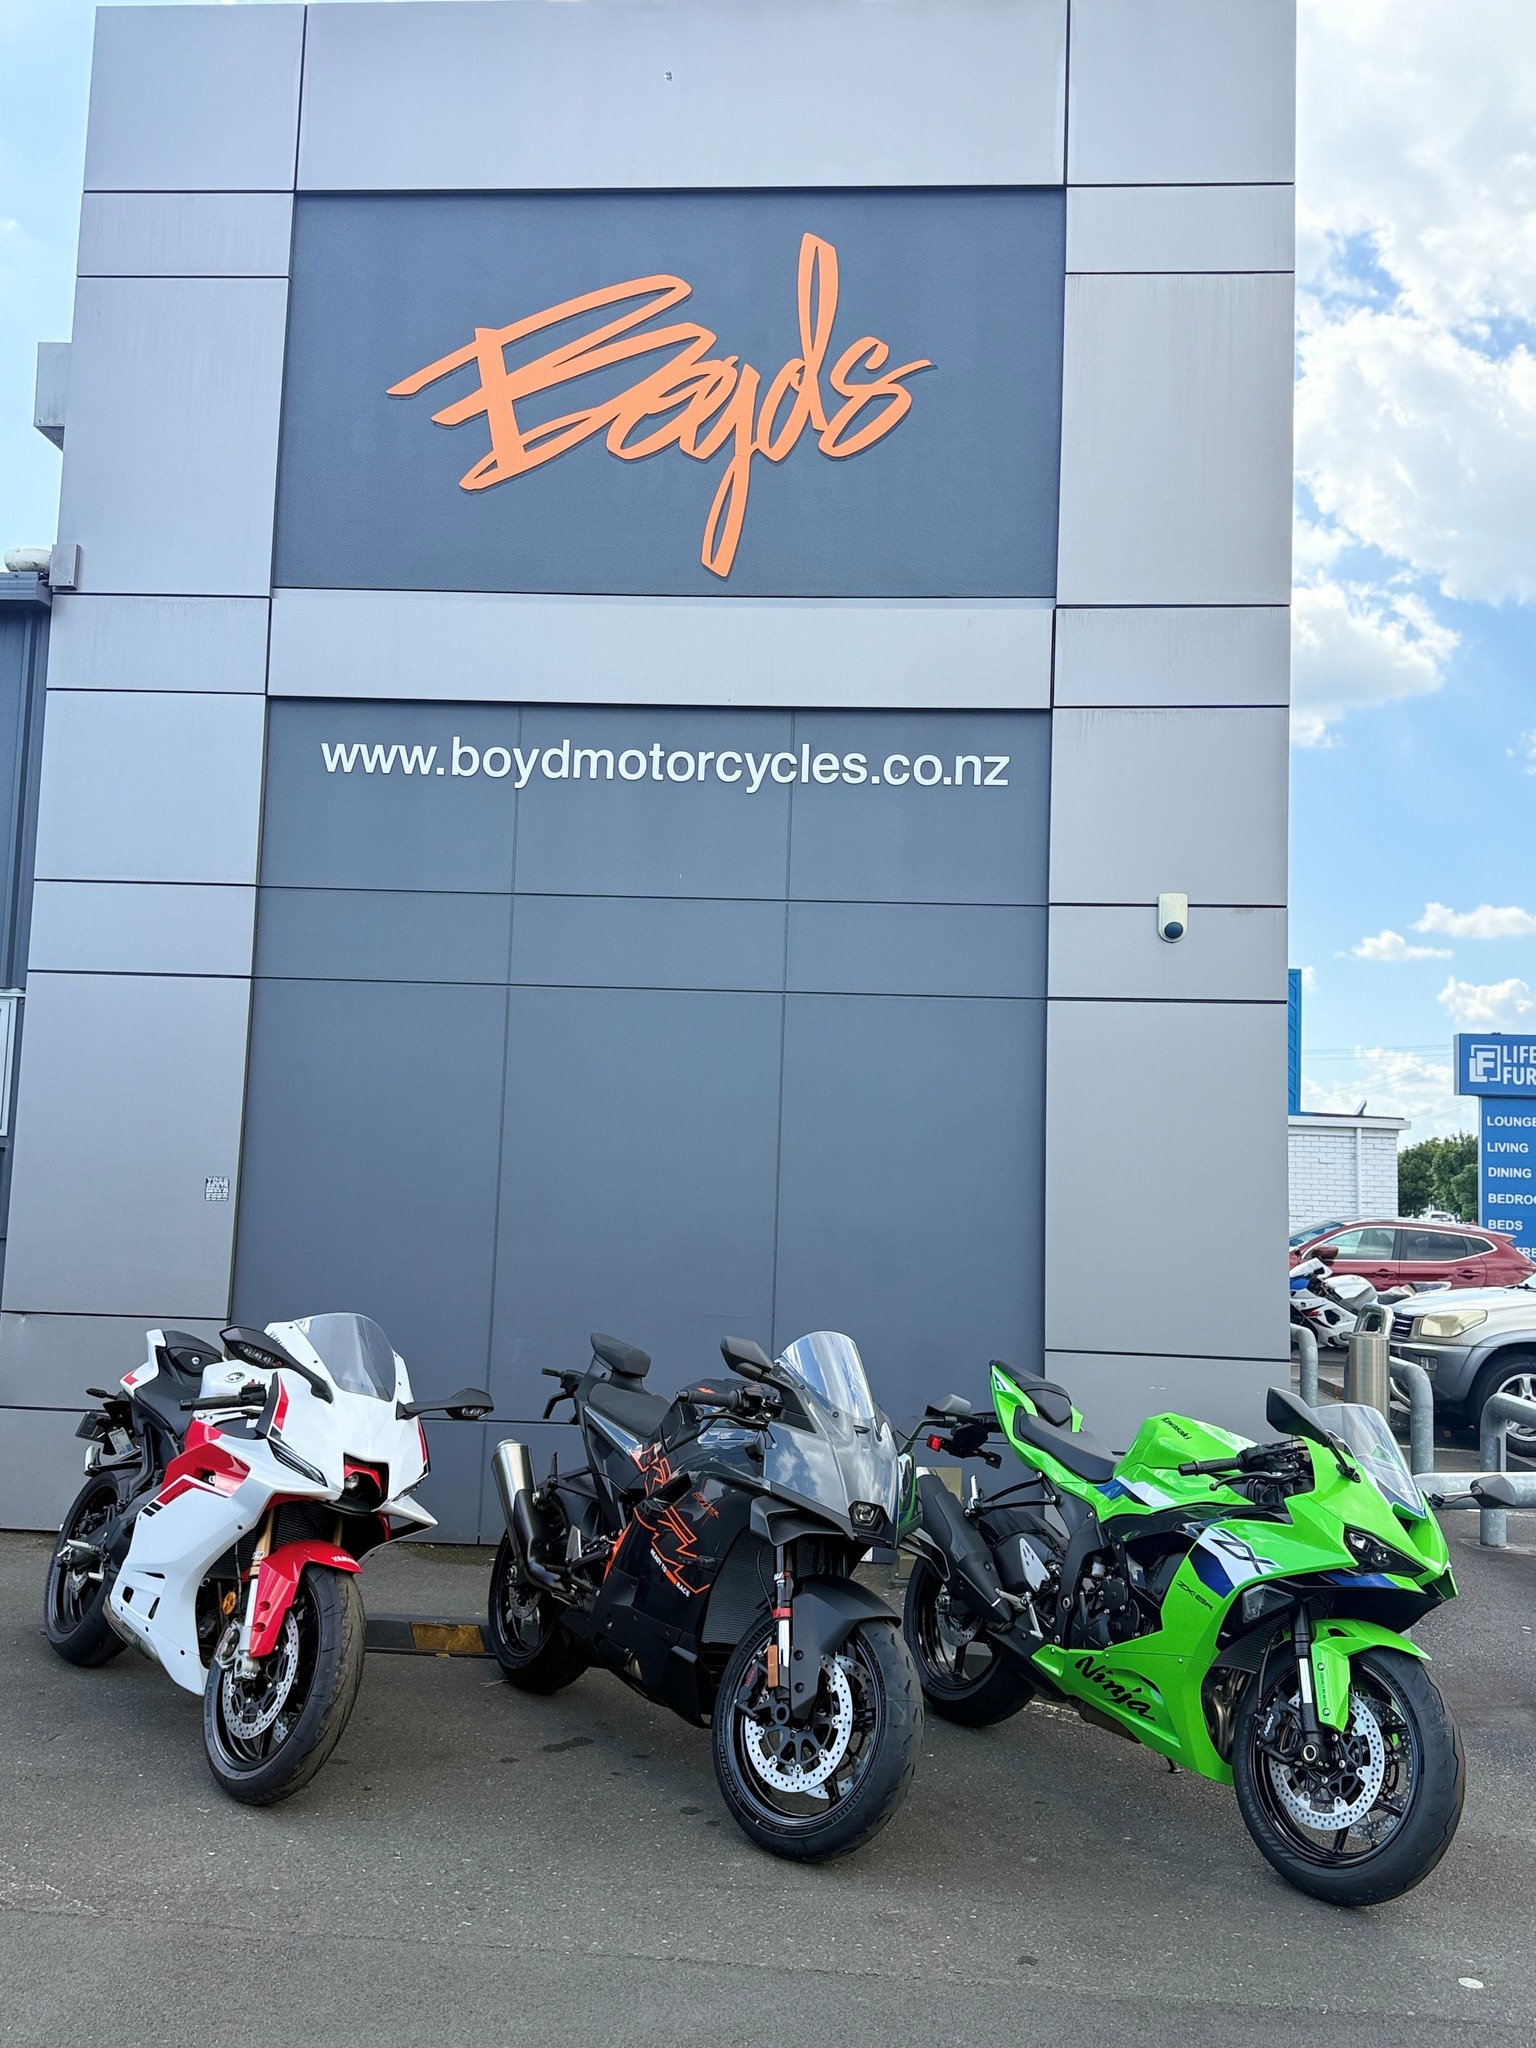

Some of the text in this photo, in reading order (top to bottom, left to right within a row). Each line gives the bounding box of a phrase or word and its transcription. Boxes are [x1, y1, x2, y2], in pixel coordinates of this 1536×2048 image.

[386, 232, 931, 578] Boyds
[321, 736, 1011, 794] www.boydmotorcycles.co.nz
[1503, 1066, 1536, 1085] FUR
[1487, 1142, 1529, 1153] LIVING
[1488, 1167, 1532, 1178] DINING
[1488, 1193, 1536, 1205] BEDRO
[1488, 1219, 1523, 1231] BEDS
[676, 1581, 690, 1597] RACE
[1074, 1655, 1156, 1722] Ninja
